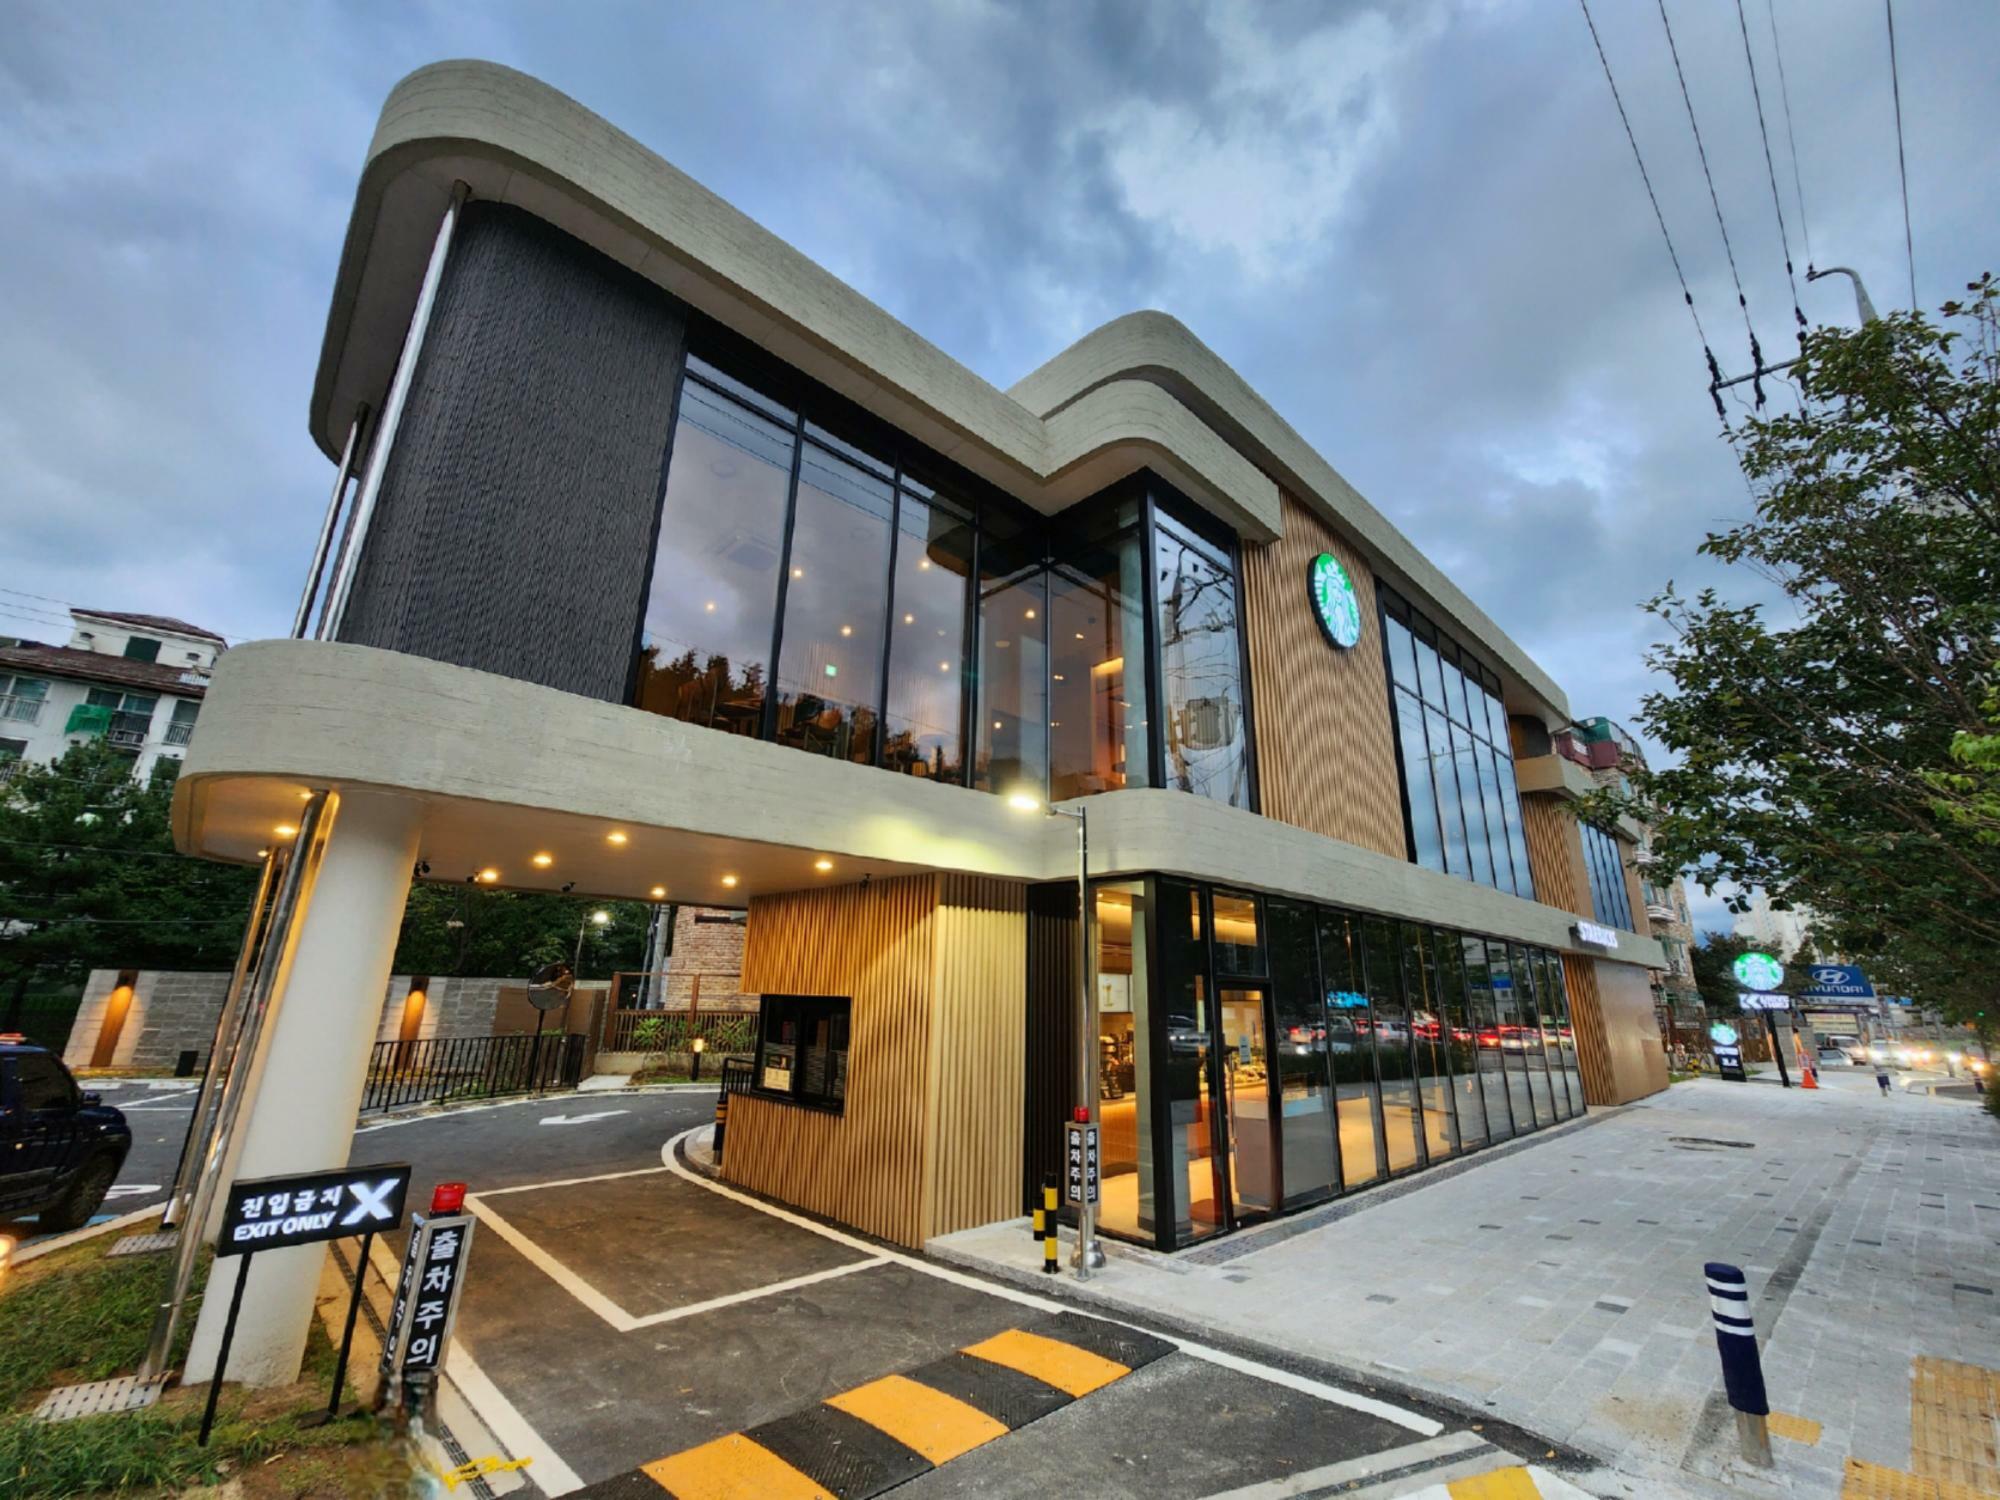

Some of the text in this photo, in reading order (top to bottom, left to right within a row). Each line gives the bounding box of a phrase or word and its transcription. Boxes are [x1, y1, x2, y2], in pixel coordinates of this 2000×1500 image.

[240, 1184, 343, 1219] 진입금지
[233, 1211, 337, 1242] EXIT ONLY
[406, 1230, 459, 1364] 출차주의
